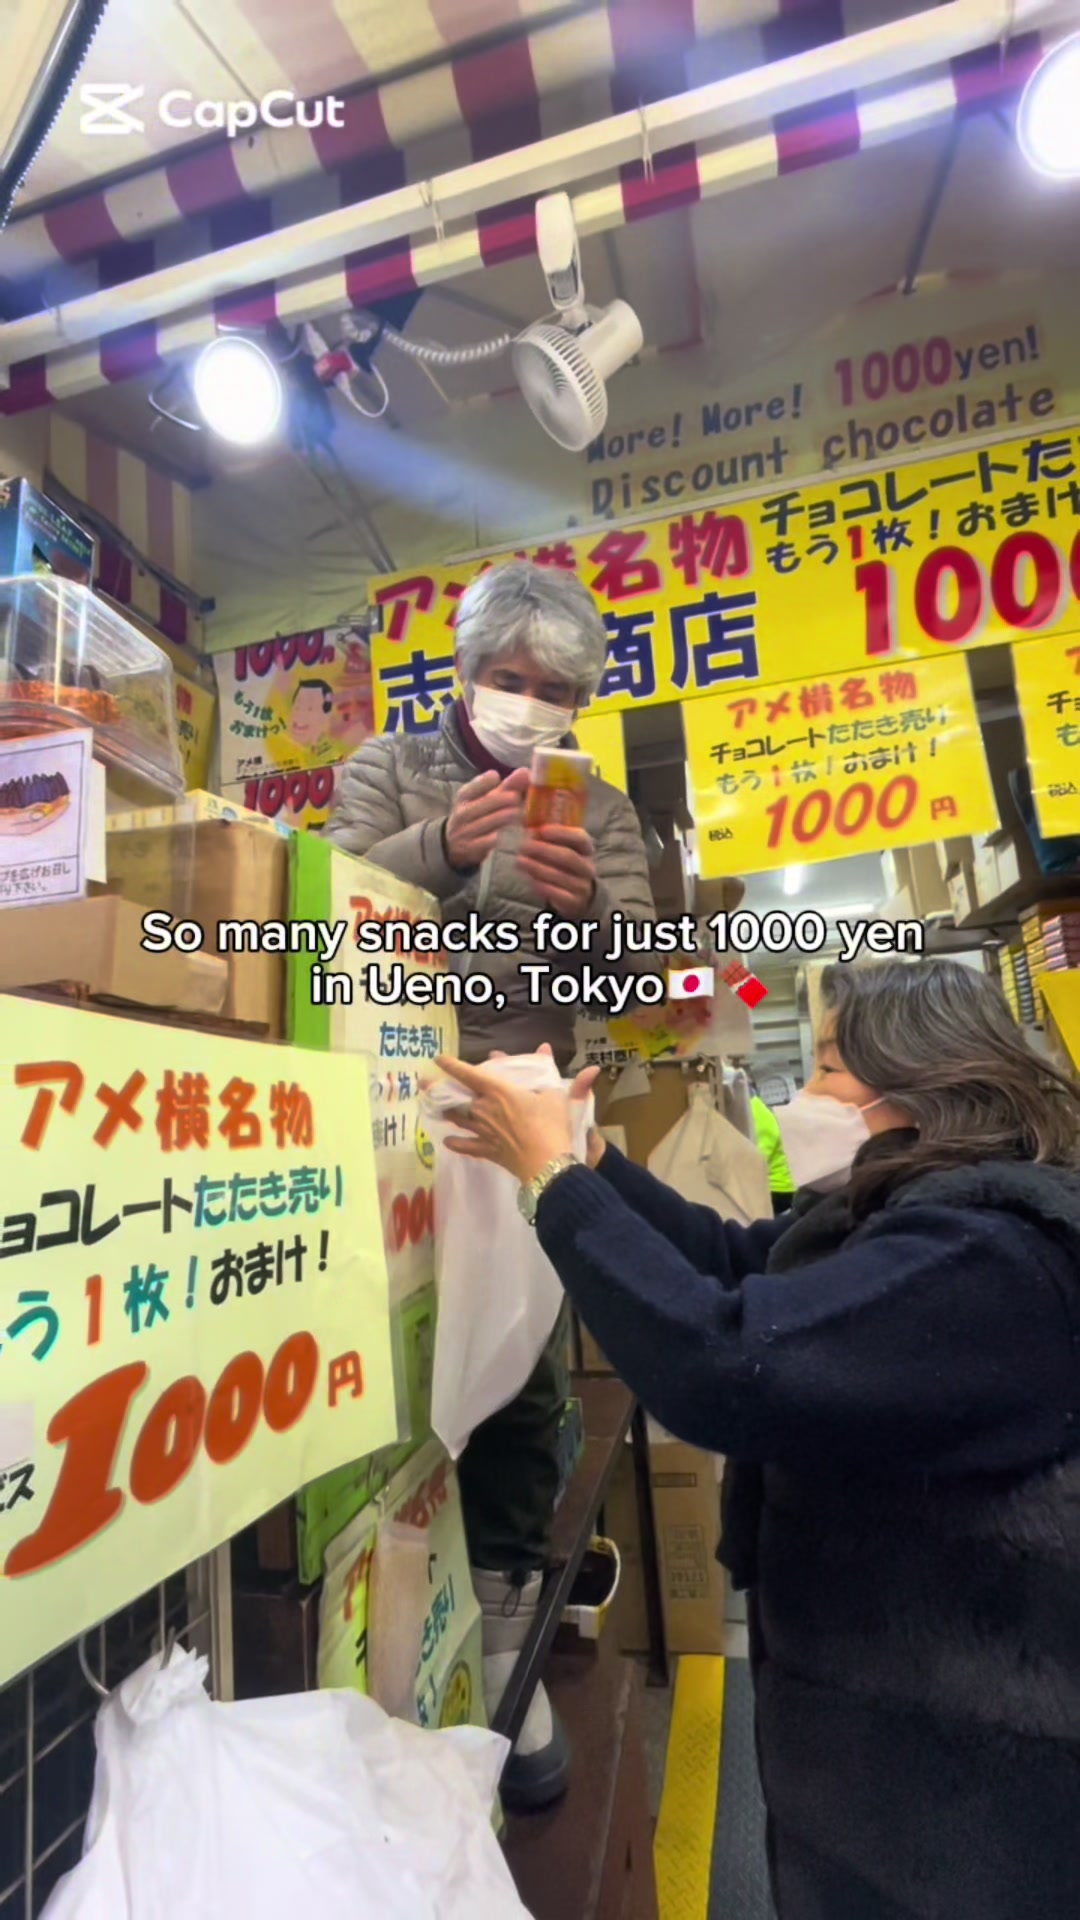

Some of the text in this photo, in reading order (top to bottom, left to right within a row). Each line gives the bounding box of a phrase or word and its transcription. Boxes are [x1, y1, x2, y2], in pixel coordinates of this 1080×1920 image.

[587, 325, 1041, 464] More! More! 1000yen!
[592, 384, 1056, 514] Discount chocolate
[760, 434, 1080, 536] チョコレートた
[376, 511, 751, 642] ア名物
[855, 528, 1080, 657] 100
[379, 590, 760, 735] 志商店
[727, 669, 918, 729] アメ横名物
[709, 703, 948, 765] チョコレートたたき売り
[14, 1060, 315, 1153] アメ横名物
[0, 1165, 343, 1260] ョコレートたたき売り
[0, 1230, 329, 1362] う1枚！おまけ！
